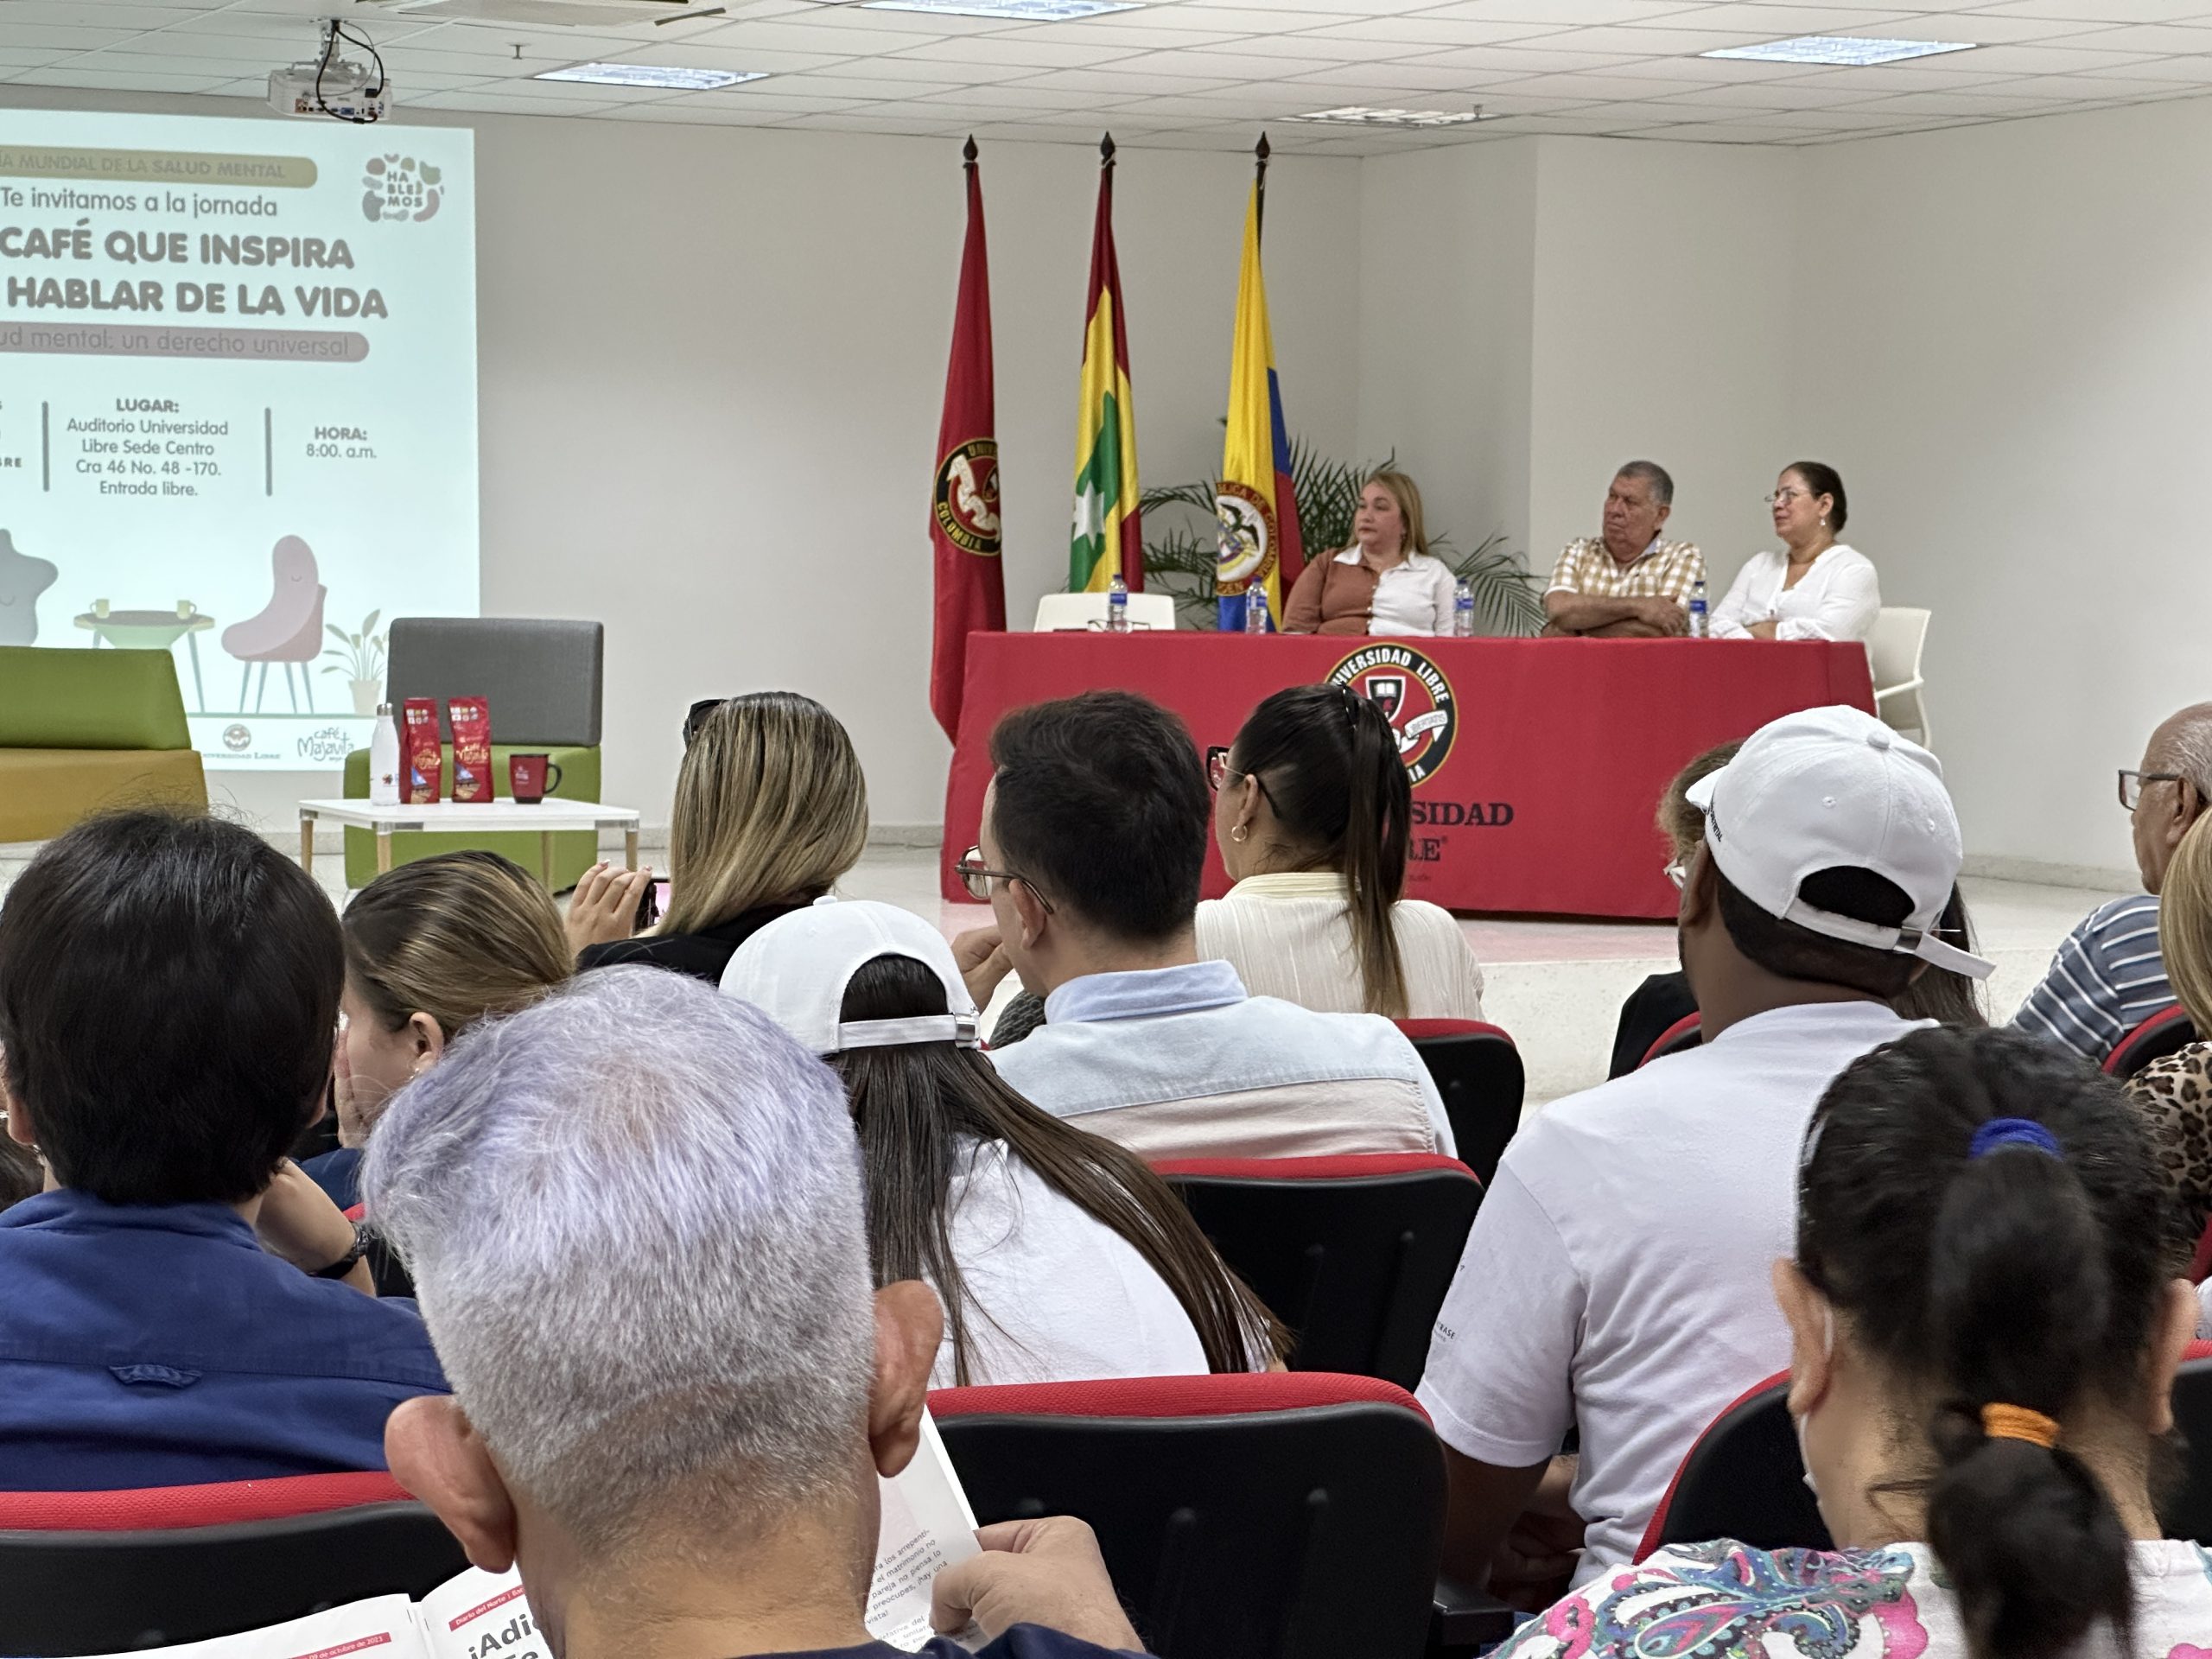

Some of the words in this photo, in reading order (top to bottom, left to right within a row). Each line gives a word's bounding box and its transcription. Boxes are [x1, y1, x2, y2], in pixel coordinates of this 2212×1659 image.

[19, 154, 96, 170] MUNDIAL
[102, 157, 122, 171] DE
[128, 159, 147, 172] LA
[152, 159, 211, 175] SALUD
[217, 162, 286, 178] MENTAL
[1, 187, 23, 207] Te
[31, 187, 137, 211] invitamos
[145, 195, 158, 212] a
[166, 191, 186, 213] la
[194, 193, 277, 219] jornada
[387, 196, 423, 207] MOS
[0, 217, 92, 259] CAFÉ
[105, 231, 188, 264] QUE
[200, 233, 355, 269] INSPIRA
[8, 276, 163, 311] HABLAR
[176, 282, 226, 314] DE
[238, 283, 285, 315] LA
[295, 285, 388, 319] VIDA
[122, 334, 149, 351] un
[157, 330, 245, 353] derecho
[253, 334, 348, 356] universal
[116, 398, 180, 413] LUGAR:
[67, 417, 135, 433] Auditorio
[140, 419, 228, 435] Universidad
[314, 426, 367, 441] HORA:
[82, 439, 118, 453] Libre
[123, 439, 161, 454] Sede
[166, 441, 214, 455] Centro
[346, 448, 377, 459] a.m.
[75, 459, 102, 473] Cra
[107, 460, 125, 474] 46
[131, 461, 156, 474] No.
[161, 461, 180, 474] 48
[100, 480, 157, 495] Entrada
[162, 480, 198, 496] libre.
[938, 501, 982, 550] COLOMBIA
[1416, 662, 1449, 703] LIBRE
[885, 1554, 896, 1565] los
[897, 1529, 930, 1556] arrepenti-
[887, 1547, 925, 1577] matrimonio
[925, 1540, 936, 1549] no
[872, 1581, 897, 1599] pareja
[899, 1574, 908, 1584] no
[910, 1557, 932, 1577] piensa
[933, 1560, 948, 1573] una
[455, 1611, 475, 1625] Diario
[475, 1604, 486, 1616] del
[486, 1596, 506, 1610] Norte
[468, 1613, 539, 1659] ¡Adi
